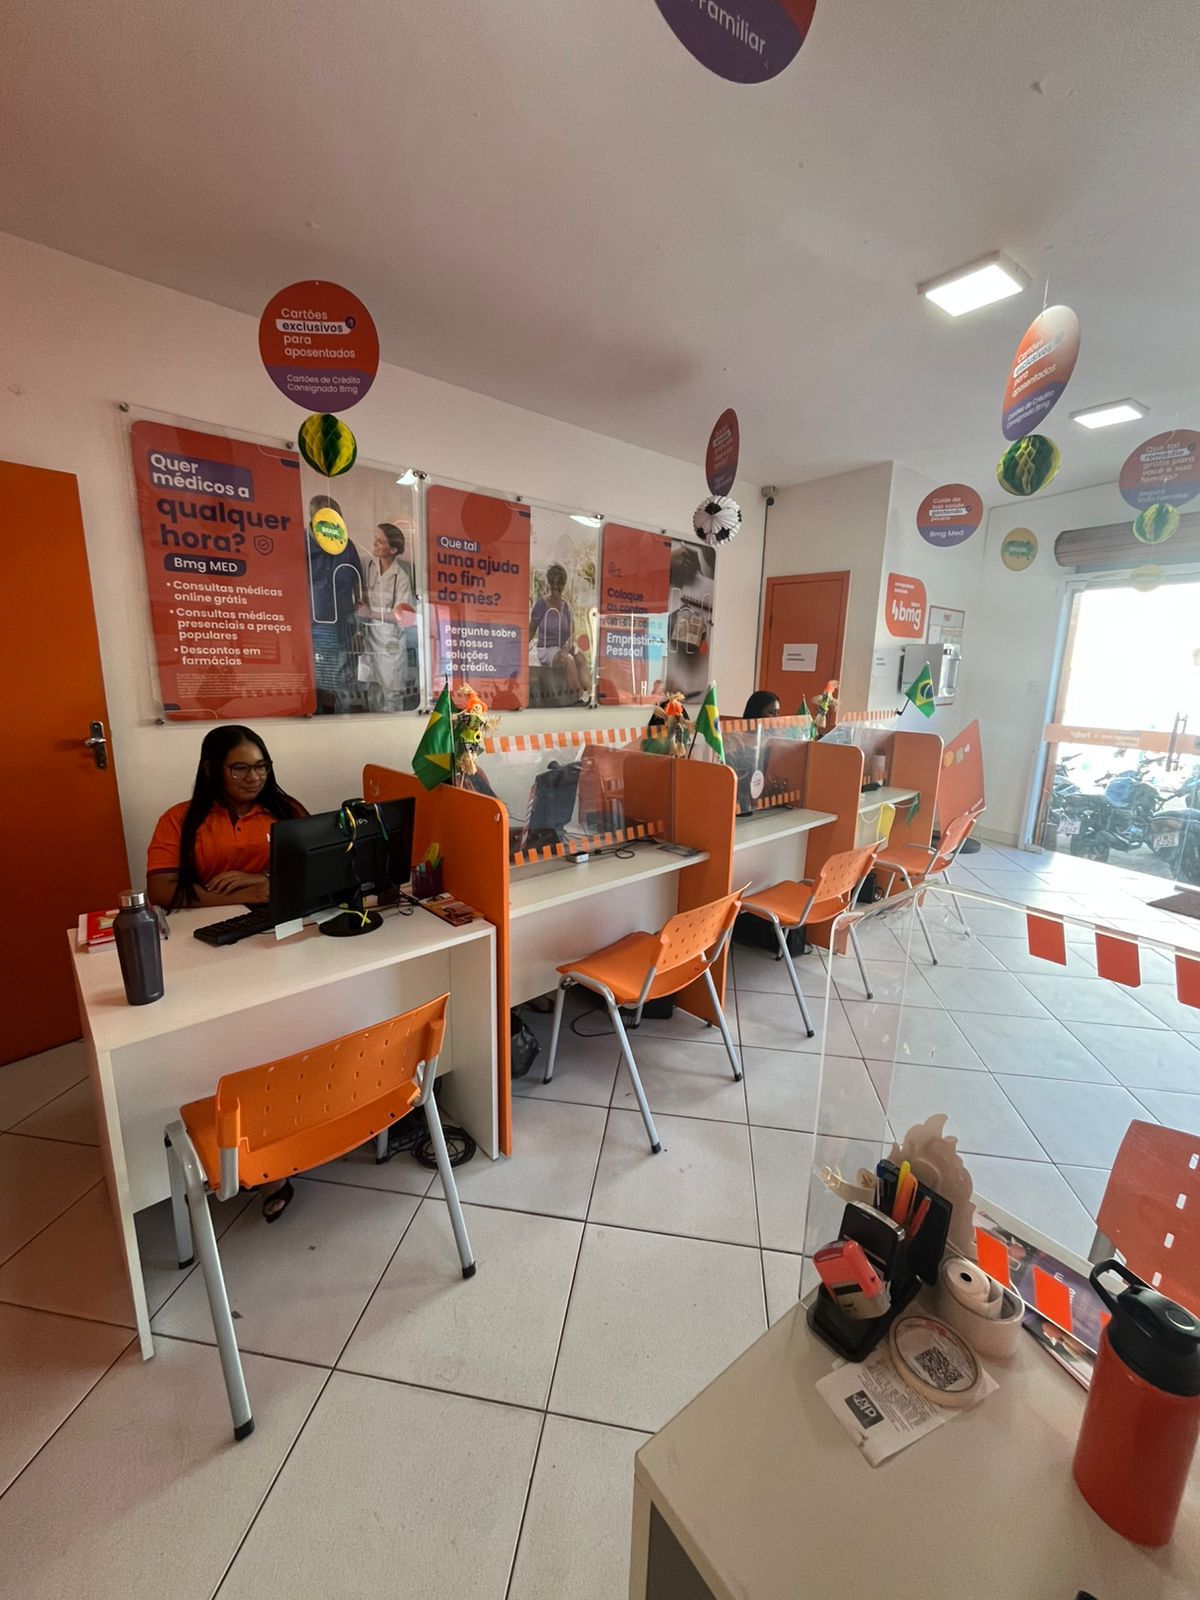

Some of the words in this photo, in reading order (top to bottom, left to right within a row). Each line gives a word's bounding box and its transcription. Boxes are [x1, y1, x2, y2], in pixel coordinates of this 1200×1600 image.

[281, 308, 328, 320] Cartões
[282, 321, 344, 333] exclusivos
[283, 335, 312, 346] para
[284, 347, 356, 359] aposentados
[286, 374, 319, 383] Cartões
[320, 375, 331, 384] de
[332, 375, 361, 384] Crédito
[287, 383, 338, 394] Consignado
[339, 385, 358, 395] Bmg
[150, 453, 199, 474] Quer
[152, 471, 235, 496] médicos
[237, 486, 250, 498] a
[156, 498, 291, 532] qualquer
[160, 523, 246, 553] hora?
[440, 536, 462, 548] Que
[463, 540, 478, 551] tal
[173, 557, 207, 573] Bmg
[210, 560, 238, 572] MED
[437, 552, 474, 568] uma
[477, 556, 519, 575] ajuda
[437, 571, 458, 583] no
[460, 570, 486, 587] fim
[173, 580, 234, 593] Consultas
[236, 585, 283, 597] médicas
[607, 587, 644, 603] Coloque
[174, 592, 212, 602] online
[213, 595, 248, 606] grátis
[437, 587, 458, 602] do
[460, 591, 501, 606] mês?
[176, 608, 236, 619] Consultas
[238, 611, 285, 621] médicas
[898, 600, 922, 631] bmg
[177, 620, 245, 630] presenciais
[256, 623, 292, 634] preços
[444, 624, 490, 638] Pergunte
[491, 628, 517, 638] sobre
[179, 631, 238, 641] populares
[445, 638, 458, 647] as
[459, 639, 493, 648] nossas
[180, 645, 241, 655] Descontos
[446, 650, 489, 662] soluções
[606, 645, 643, 657] Pessoal
[182, 656, 242, 665] farmácias
[446, 662, 459, 671] de
[460, 661, 497, 672] crédito.
